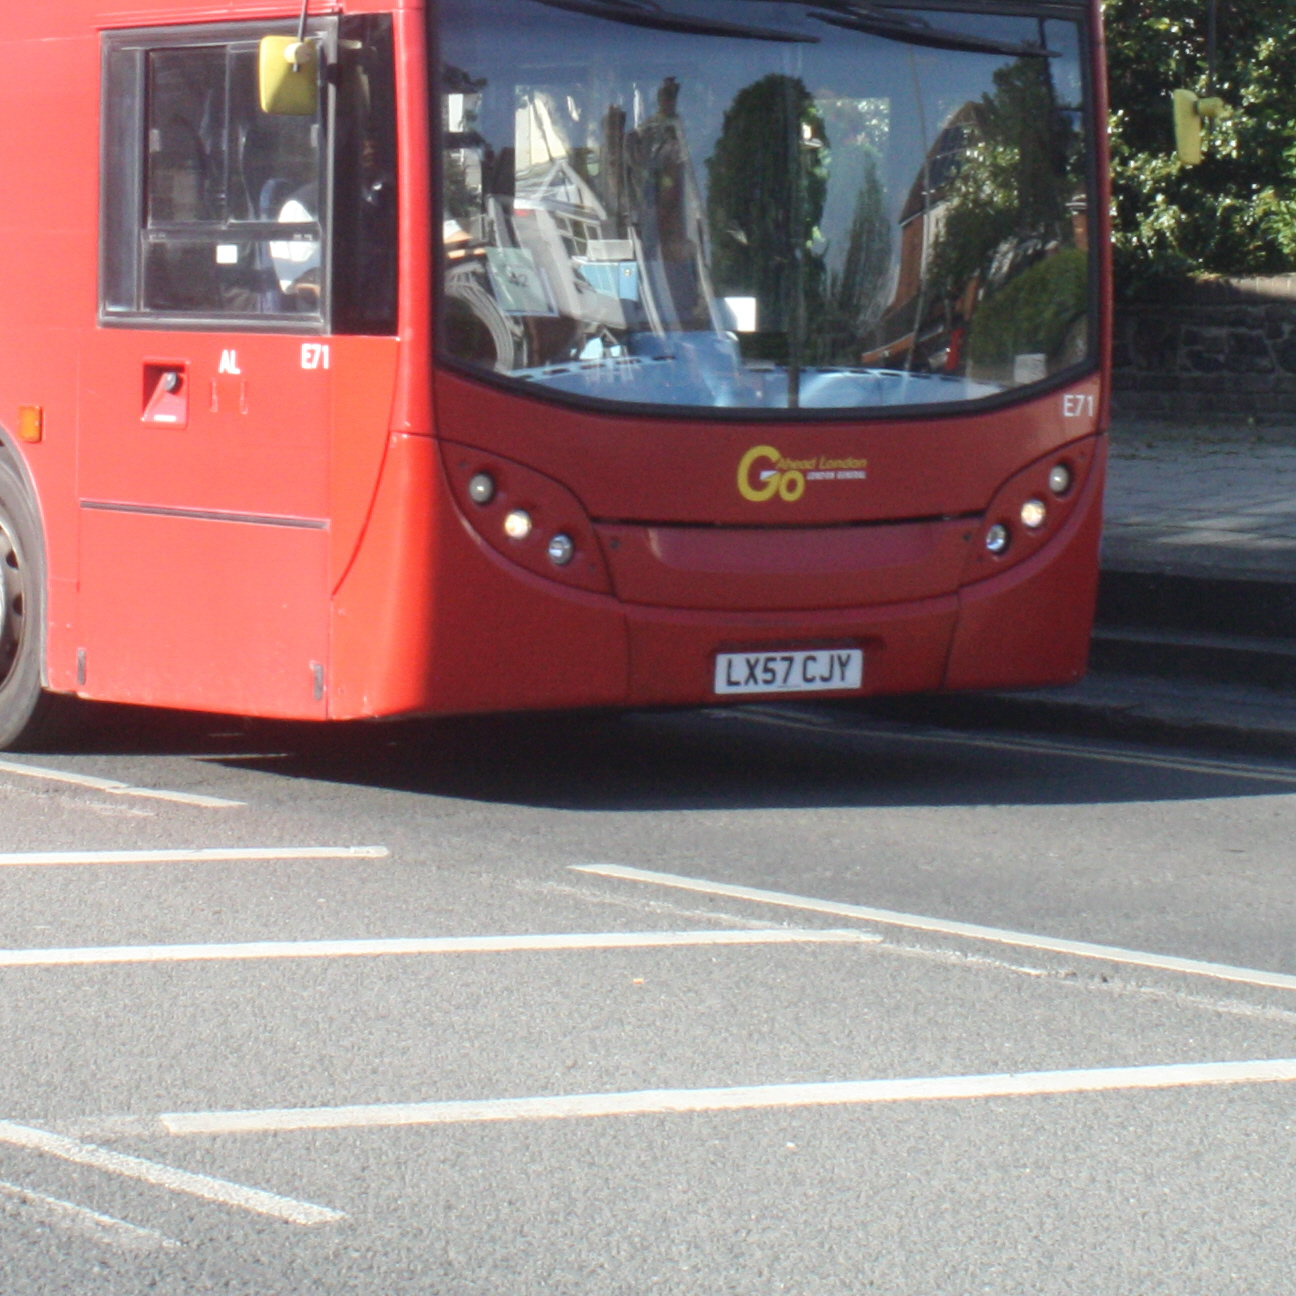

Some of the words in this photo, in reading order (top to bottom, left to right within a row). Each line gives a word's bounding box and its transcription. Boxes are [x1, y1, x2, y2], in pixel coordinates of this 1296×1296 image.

[218, 349, 241, 375] AL
[301, 343, 330, 370] E71
[1063, 394, 1094, 417] E71
[737, 445, 805, 502] Go
[726, 656, 794, 687] LX57
[803, 654, 851, 683] CJY
